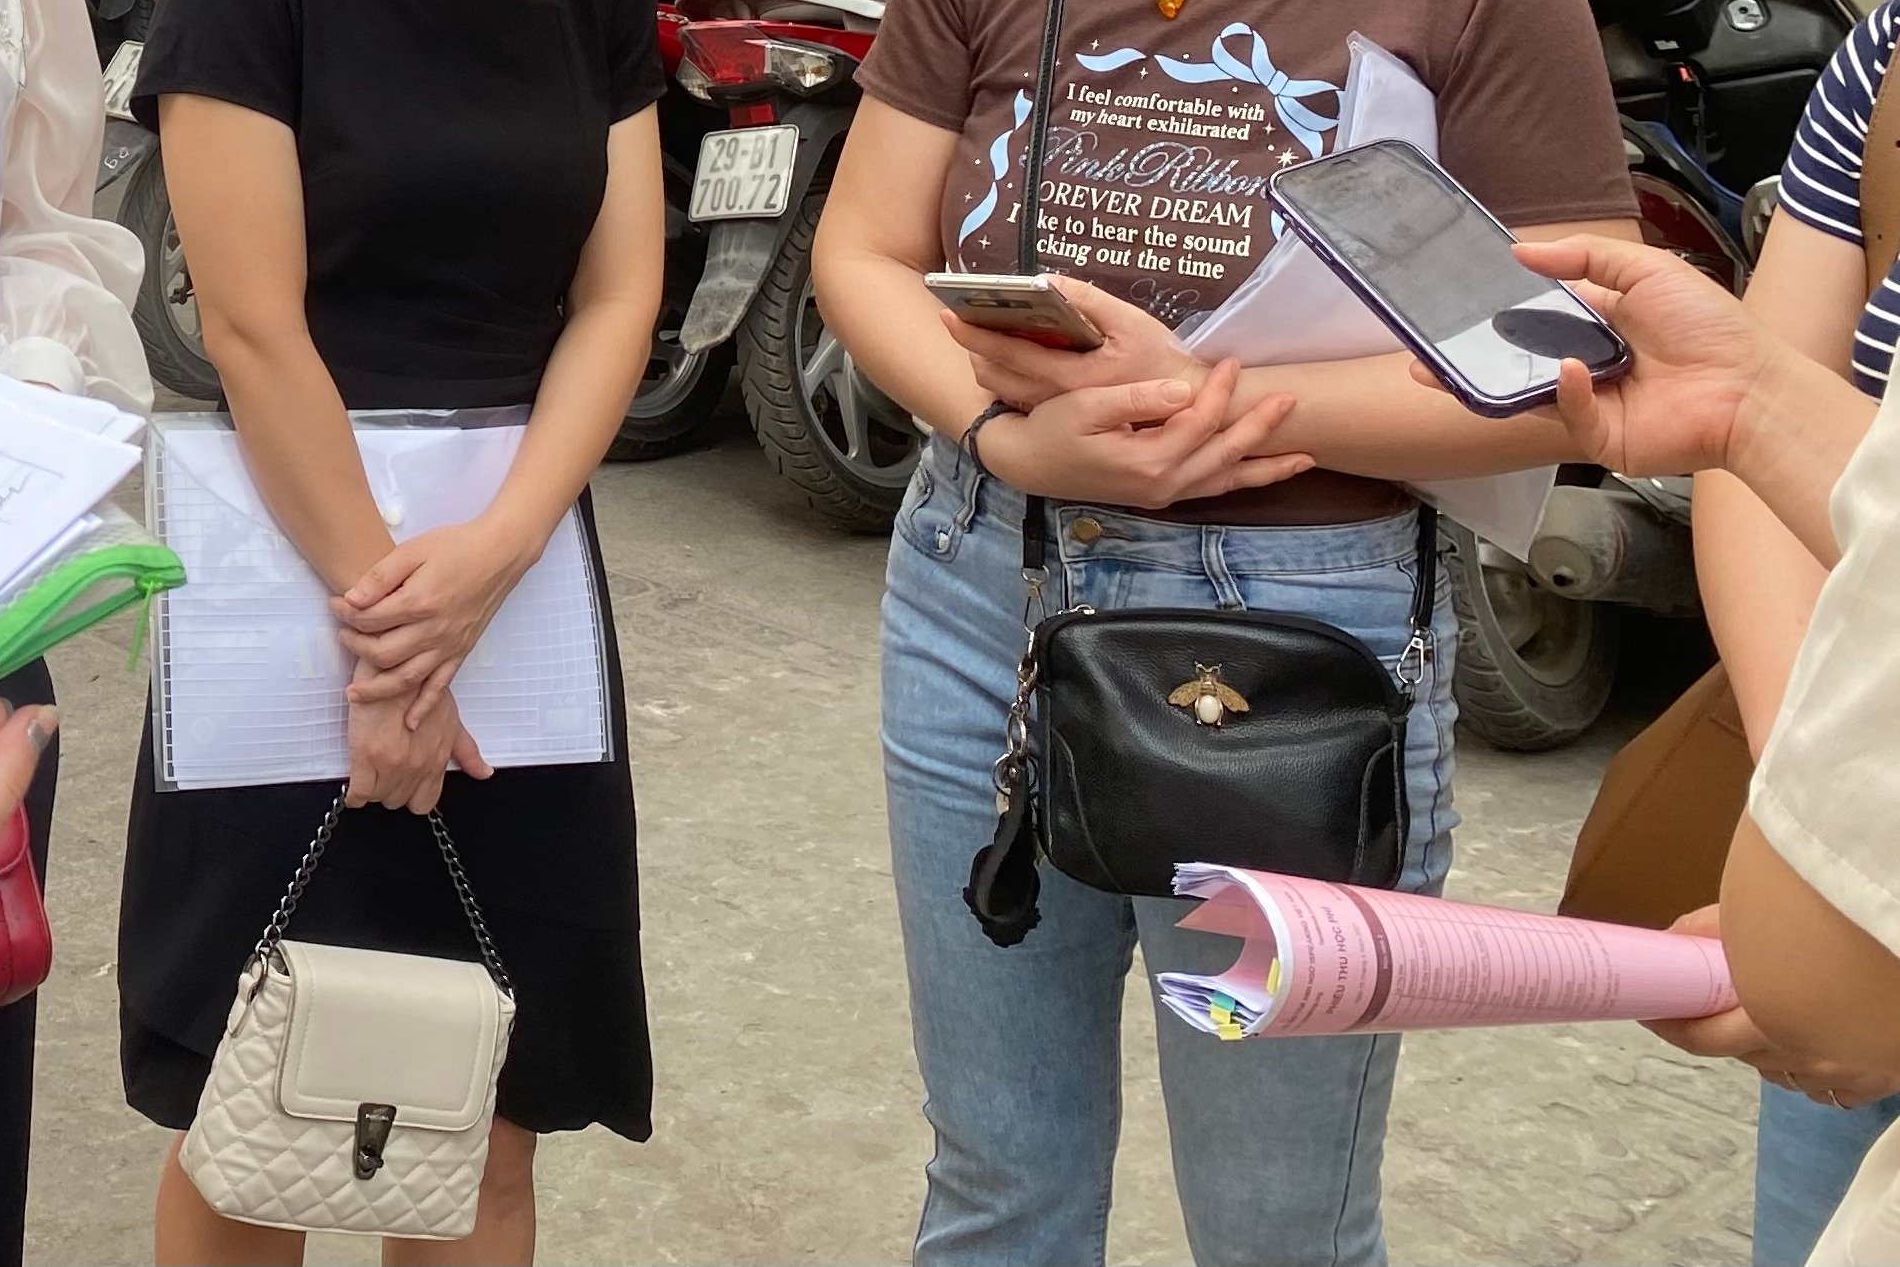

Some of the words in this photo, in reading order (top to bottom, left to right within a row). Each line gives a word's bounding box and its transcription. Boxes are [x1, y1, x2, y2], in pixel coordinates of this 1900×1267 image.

[1066, 83, 1076, 100] I
[1078, 84, 1111, 106] feel
[1113, 92, 1223, 117] comfortable
[1227, 103, 1265, 122] with
[1070, 108, 1096, 128] my
[1096, 108, 1142, 130] heart
[1146, 113, 1251, 141] exhilarated
[709, 134, 780, 173] 29-B1
[695, 174, 781, 214] 700.72
[1039, 180, 1143, 217] OREVER
[1149, 197, 1254, 228] DREAM
[1065, 216, 1085, 235] to
[1091, 217, 1138, 244] hear
[1144, 225, 1177, 249] the
[1182, 235, 1251, 257] sound
[1036, 234, 1092, 266] cking
[1096, 247, 1132, 268] out
[1137, 249, 1171, 272] the
[1177, 255, 1225, 280] time
[1331, 926, 1345, 951] HỌC
[1337, 956, 1348, 980] THU
